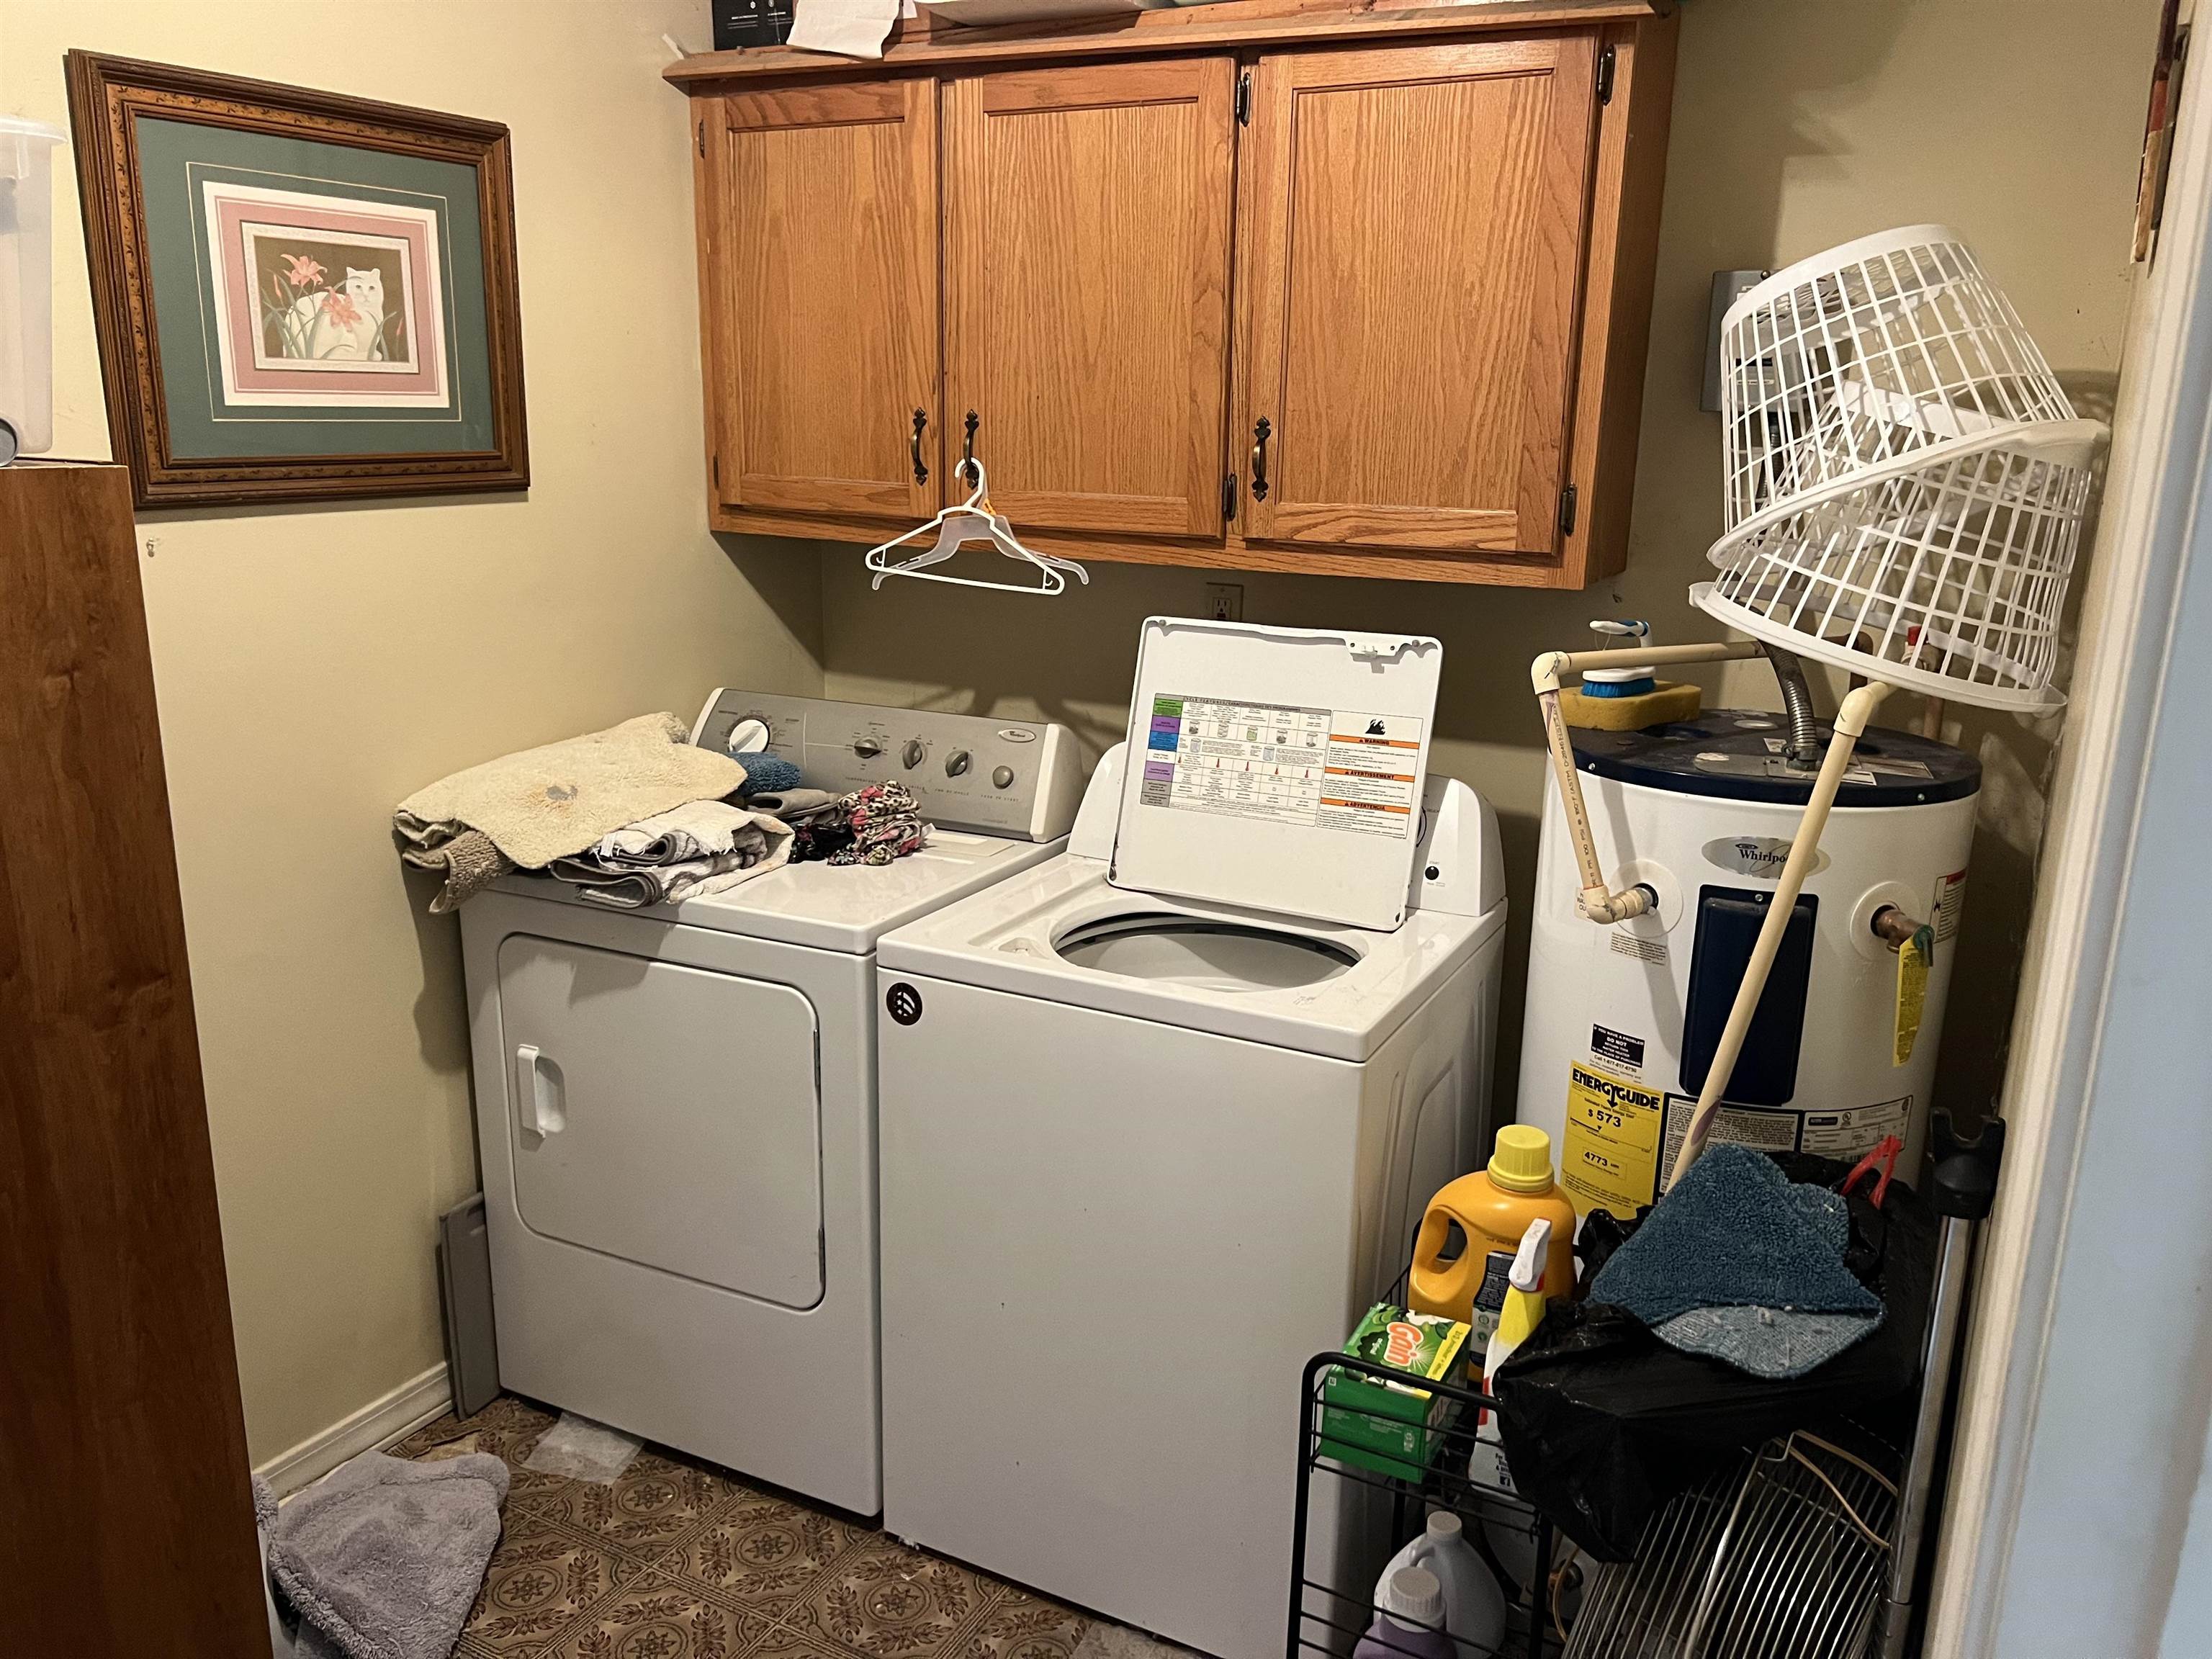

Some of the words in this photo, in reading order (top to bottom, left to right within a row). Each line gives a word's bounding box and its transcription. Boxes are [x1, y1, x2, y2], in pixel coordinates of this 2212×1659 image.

[1739, 849, 1789, 865] Whirlpo
[1573, 1068, 1660, 1111] ENERGYGUIDE
[1588, 1109, 1593, 1118] $
[1596, 1110, 1622, 1128] 573
[1584, 1151, 1609, 1167] 4773
[1385, 1322, 1424, 1366] Gain
